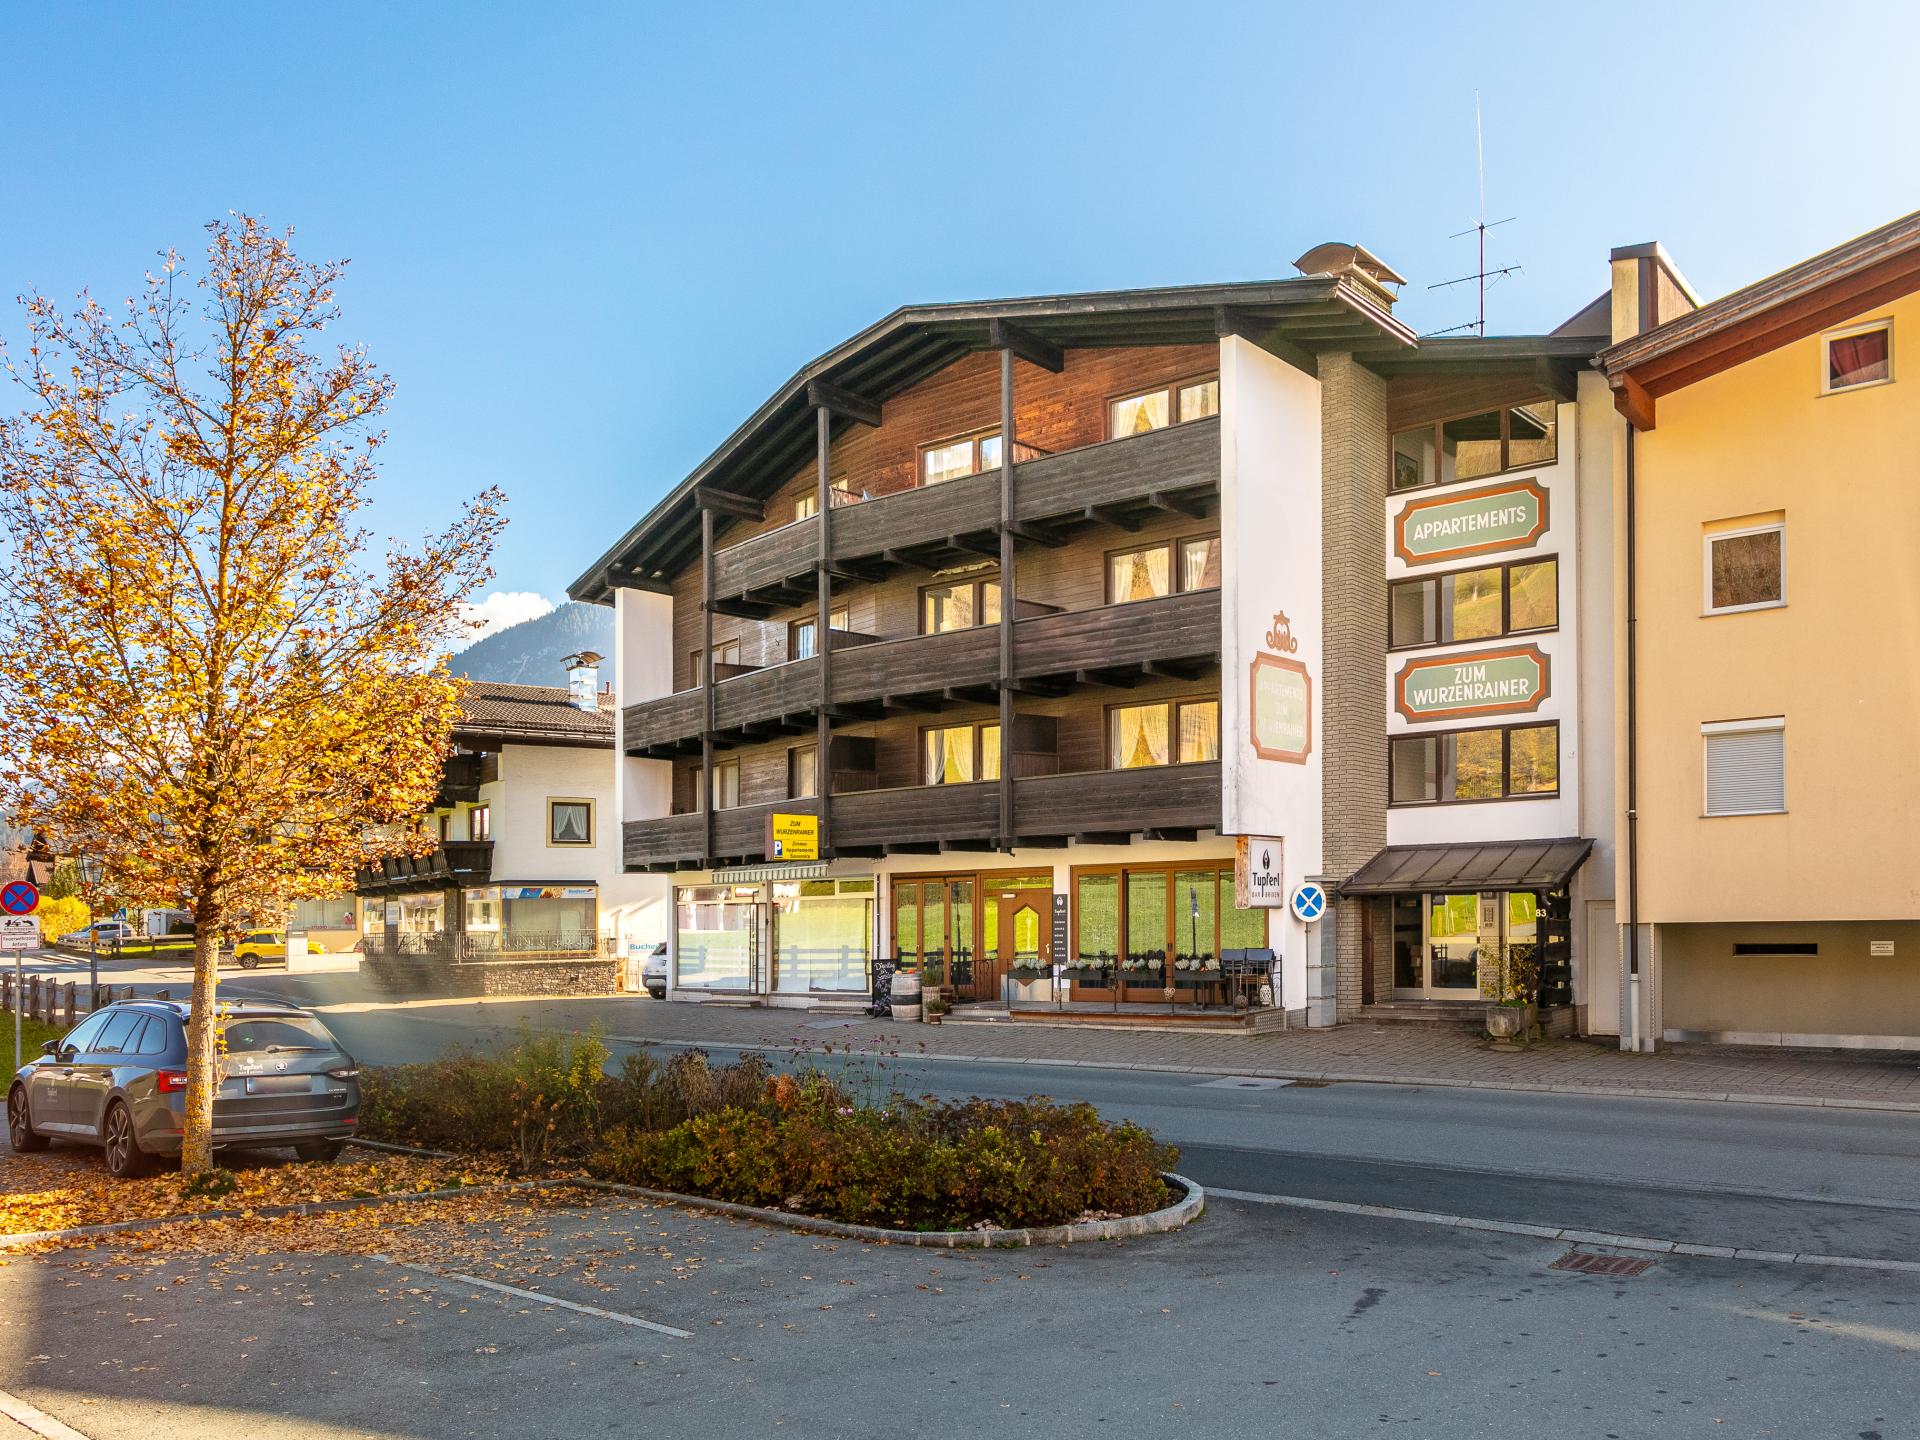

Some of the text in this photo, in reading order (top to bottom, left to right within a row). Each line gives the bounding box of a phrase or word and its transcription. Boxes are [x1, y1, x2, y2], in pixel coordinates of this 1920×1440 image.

[1413, 506, 1526, 540] APPARTEMENTS
[1454, 665, 1486, 684] ZUM
[1413, 678, 1529, 705] WURZENRAINER
[1252, 872, 1280, 898] Tupferl
[1536, 909, 1547, 918] 83
